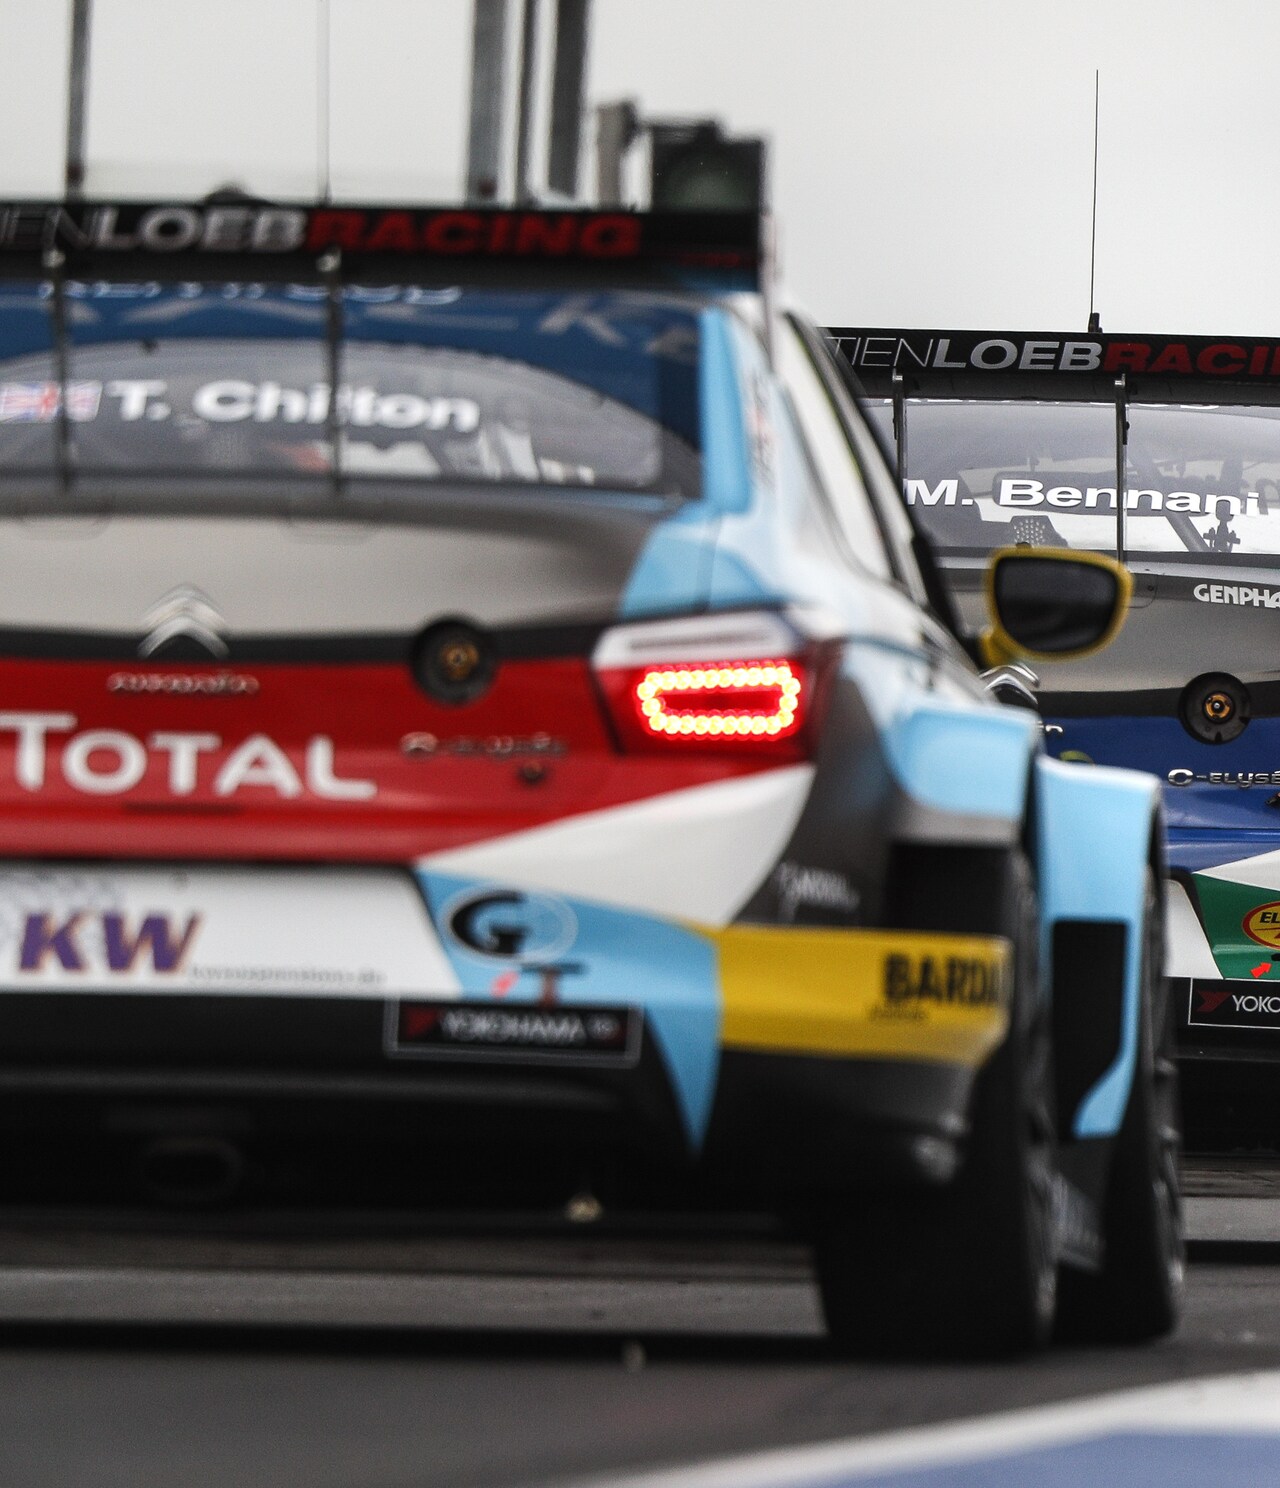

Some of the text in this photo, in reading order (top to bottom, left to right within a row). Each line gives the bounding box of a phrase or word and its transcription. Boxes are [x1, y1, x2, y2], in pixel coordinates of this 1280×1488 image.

[106, 379, 172, 421] T.
[903, 479, 974, 507] M.
[999, 479, 1260, 518] Bennani
[0, 710, 378, 799] TOTAL
[18, 908, 203, 977] KW
